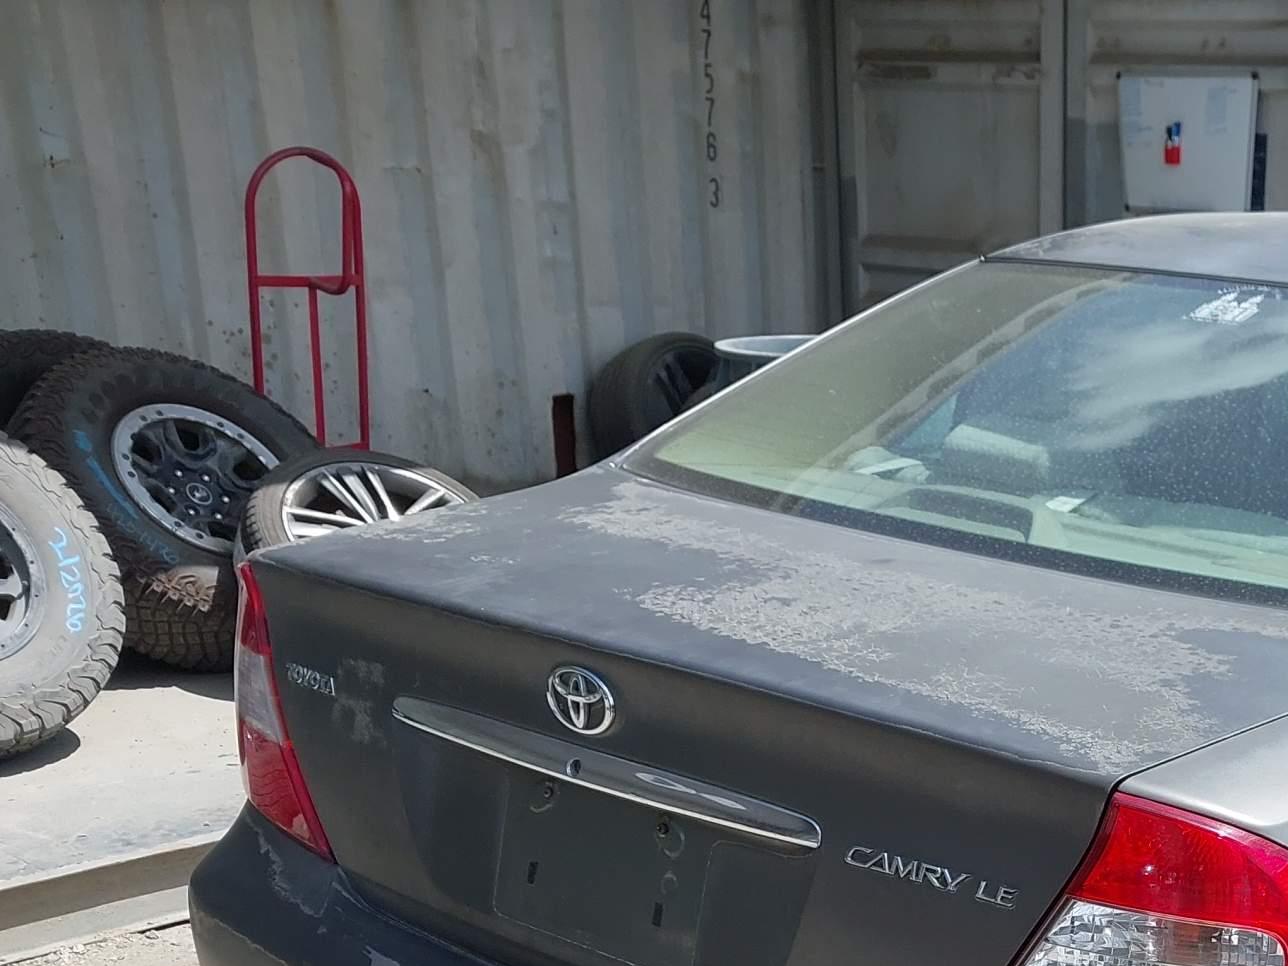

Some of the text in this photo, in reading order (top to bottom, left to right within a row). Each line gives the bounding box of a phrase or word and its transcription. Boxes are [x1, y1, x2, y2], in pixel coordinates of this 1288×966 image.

[285, 662, 336, 697] TOYOTA
[844, 846, 1018, 910] CAMRY LE
